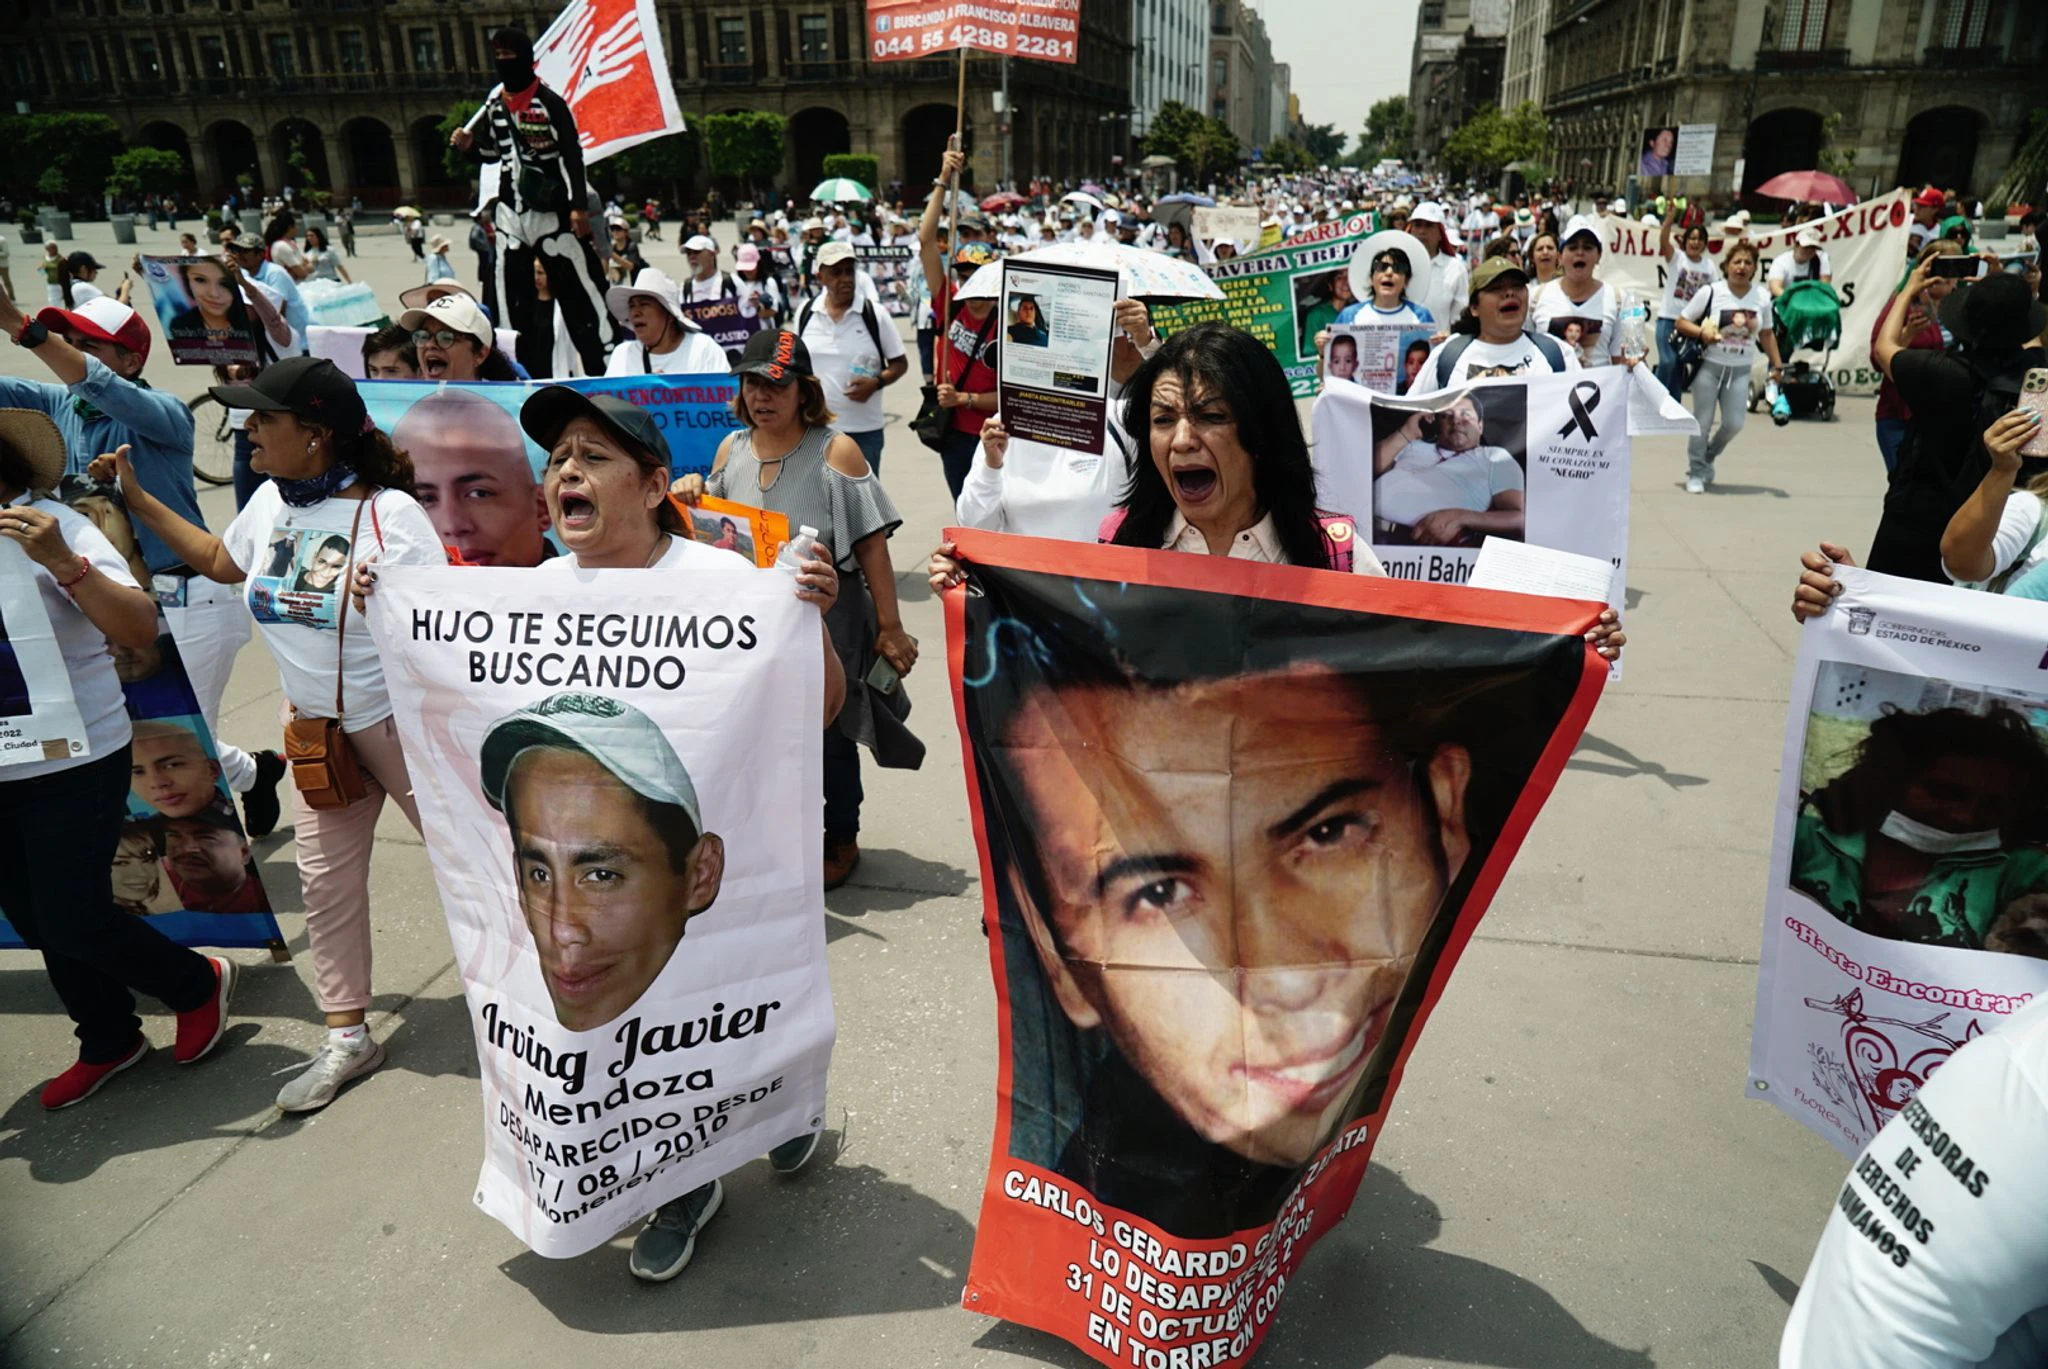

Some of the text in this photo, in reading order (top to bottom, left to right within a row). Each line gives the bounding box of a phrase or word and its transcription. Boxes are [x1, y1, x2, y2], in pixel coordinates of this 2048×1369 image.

[893, 9, 945, 29] BUSCANDO
[947, 8, 953, 20] A
[955, 3, 1016, 25] FRANCISCO
[1020, 12, 1075, 32] ALBAVERA
[874, 25, 1073, 58] 044 55 4288 2281
[868, 246, 910, 257] HASTA
[1182, 302, 1220, 316] 2012
[1224, 299, 1243, 309] EN
[1247, 296, 1266, 307] LA
[1228, 303, 1283, 319] METRO
[1539, 455, 1550, 464] MI
[1599, 461, 1610, 470] MI
[1548, 446, 1605, 458] SIEMPRE EN
[412, 608, 758, 650] HIJO TE SEGUIMOS
[1876, 629, 1918, 643] ESTADO
[1919, 635, 1934, 646] DE
[469, 650, 686, 690] BUSCANDO
[4, 739, 39, 751] Ciudad
[1865, 965, 2033, 1014] Encontrar
[482, 1001, 781, 1095] Irving Javier
[525, 1068, 714, 1126] Mendoza
[500, 1076, 784, 1168] DESAPARECIDO DESDE
[529, 1114, 729, 1204] 17 / 08 / 2010
[1895, 1146, 1922, 1180] DE
[1901, 1098, 1990, 1199] EFENSORAS
[1003, 1170, 1106, 1237] CARLOS
[1112, 1220, 1248, 1279] GERARDO
[1066, 1262, 1095, 1300] 31
[1100, 1281, 1132, 1326] DE
[1138, 1279, 1255, 1342] OCTUBRE
[1282, 1209, 1315, 1263] 208
[1089, 1239, 1121, 1277] LO
[1087, 1311, 1121, 1356] EN
[1256, 1262, 1293, 1325] COA
